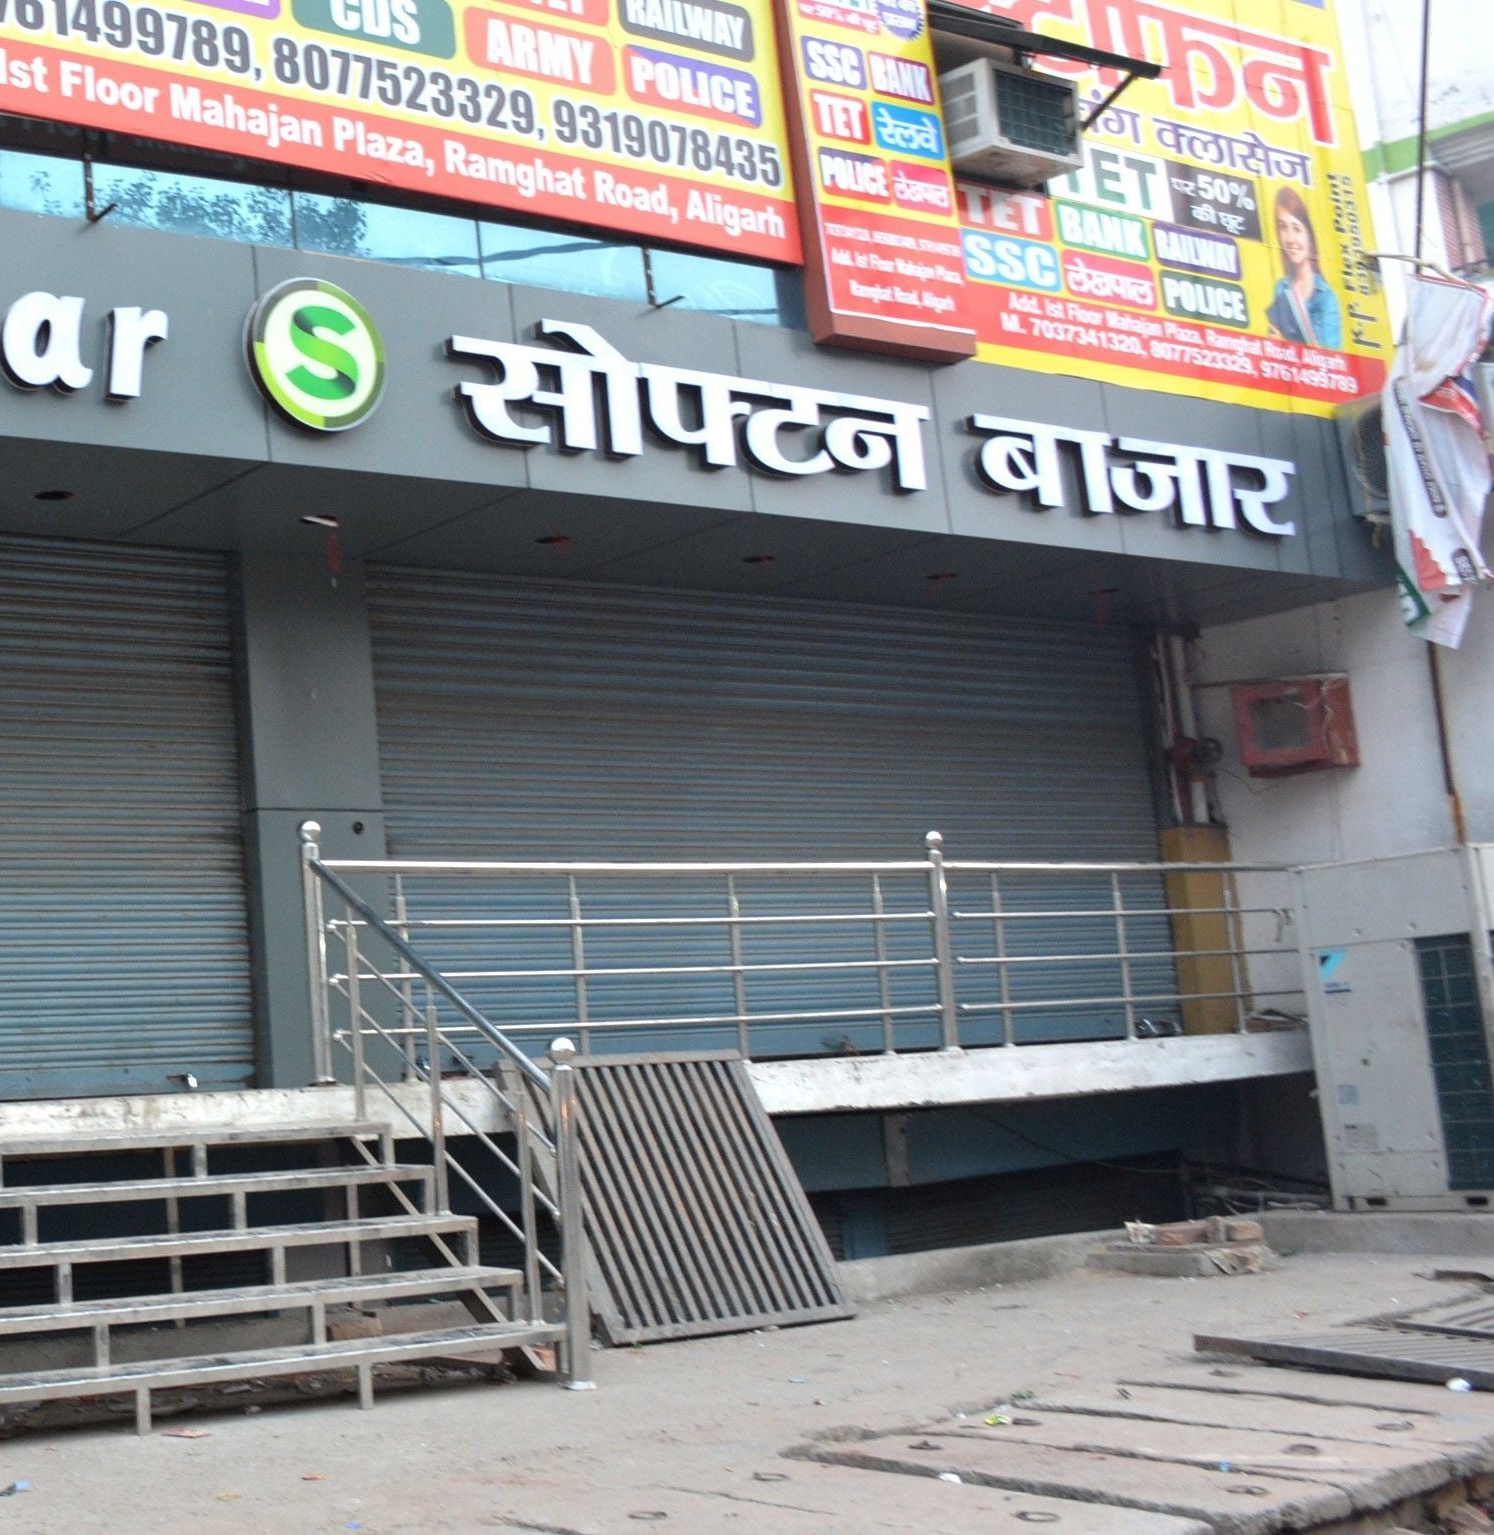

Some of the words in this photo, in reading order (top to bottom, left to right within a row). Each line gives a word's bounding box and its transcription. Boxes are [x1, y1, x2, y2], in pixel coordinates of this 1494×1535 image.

[330, 0, 421, 44] CDS
[626, 0, 745, 50] RAILWAY
[486, 17, 594, 85] ARMY
[806, 39, 862, 87] SSC
[629, 55, 756, 119] POLICE
[868, 52, 933, 104] BANK
[273, 37, 546, 141] 8077523329,
[553, 98, 782, 187] 9319078435
[812, 92, 865, 141] TET
[59, 60, 159, 114] Floor
[170, 82, 324, 148] Mahajan
[332, 116, 435, 175] Plaza,
[443, 139, 586, 199] Ramghat
[593, 169, 679, 224] Road,
[686, 187, 786, 240] Aligarh
[819, 154, 890, 198] POLICE
[1153, 118, 1311, 187] क्लासेज
[956, 181, 1044, 236] TET
[1197, 173, 1256, 212] 50%
[1057, 203, 1148, 259] BANK
[1153, 228, 1238, 275] RAILWAY
[962, 233, 1056, 288] SSC
[1163, 276, 1248, 323] POLICE
[443, 318, 931, 491] सोफ्टन
[969, 412, 1297, 537] बाजार
